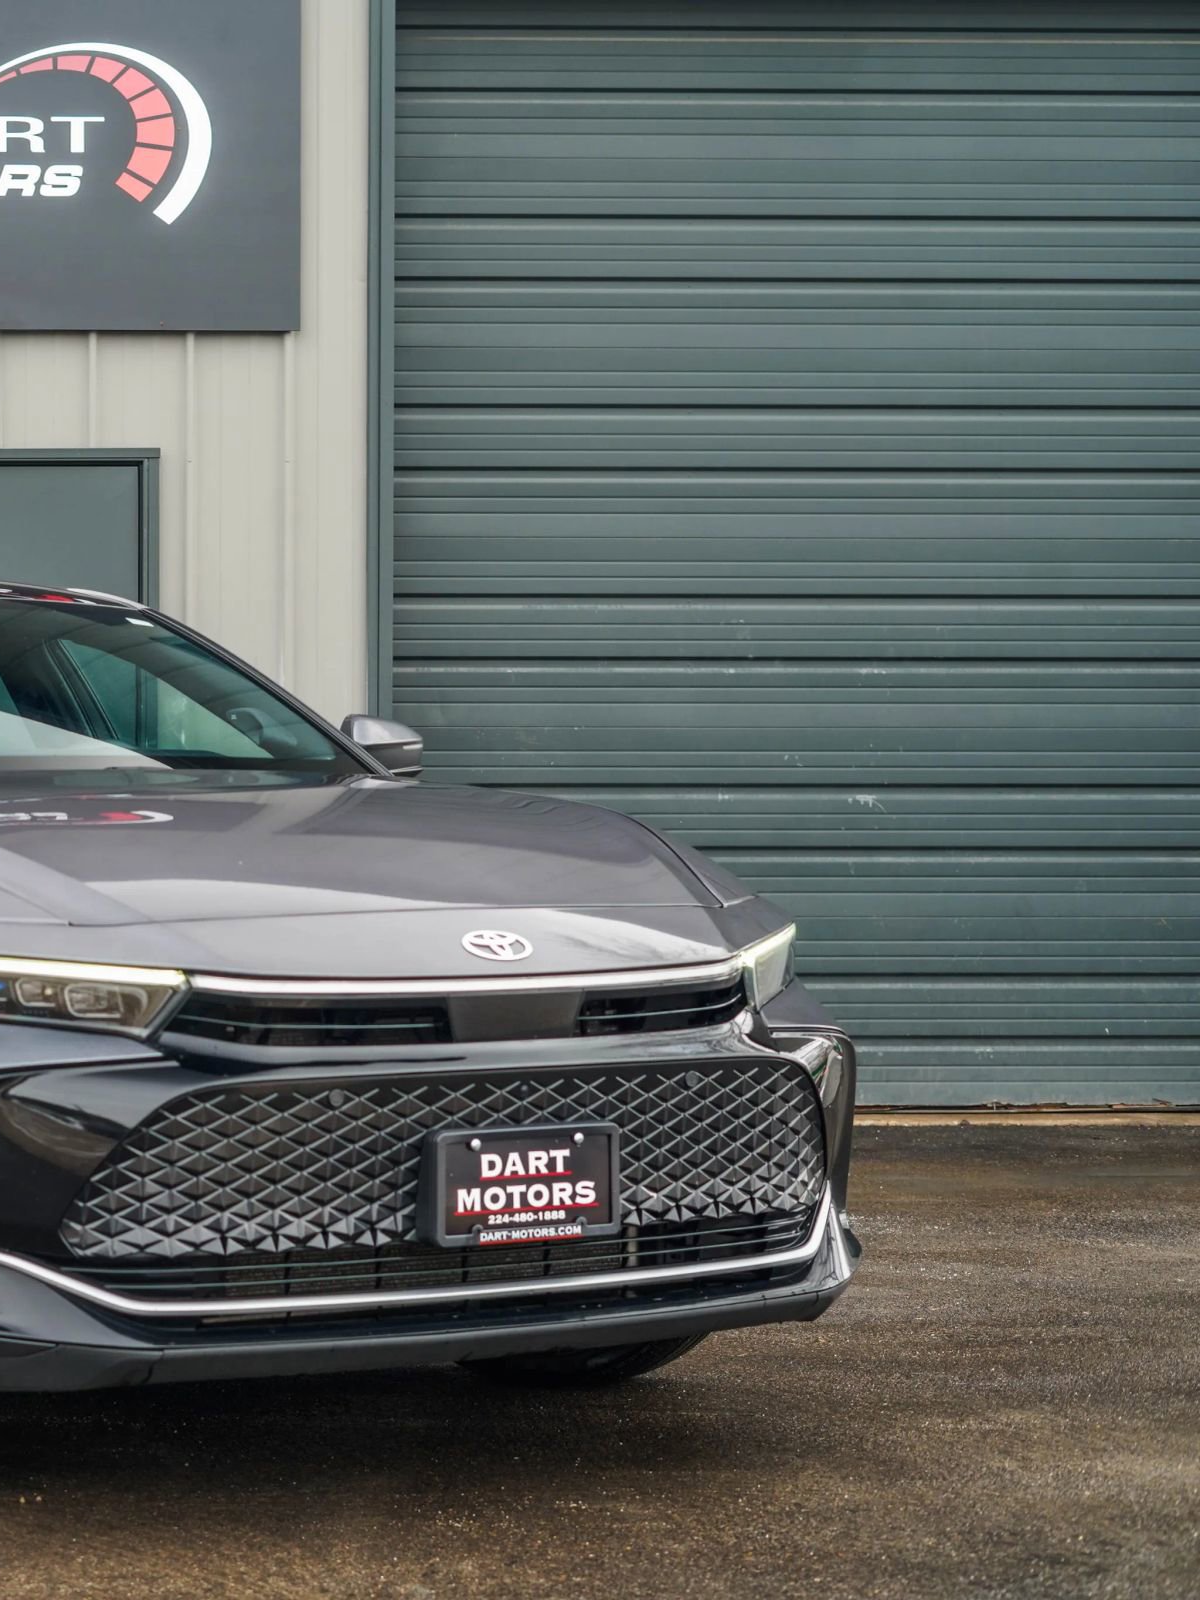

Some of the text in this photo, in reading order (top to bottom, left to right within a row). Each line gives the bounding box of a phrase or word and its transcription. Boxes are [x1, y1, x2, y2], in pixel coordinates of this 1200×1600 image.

[480, 1148, 571, 1178] DART
[457, 1181, 596, 1213] MOTORS
[487, 1209, 567, 1225] 224-480-1888
[480, 1225, 582, 1243] DART-MOTORS.COM
